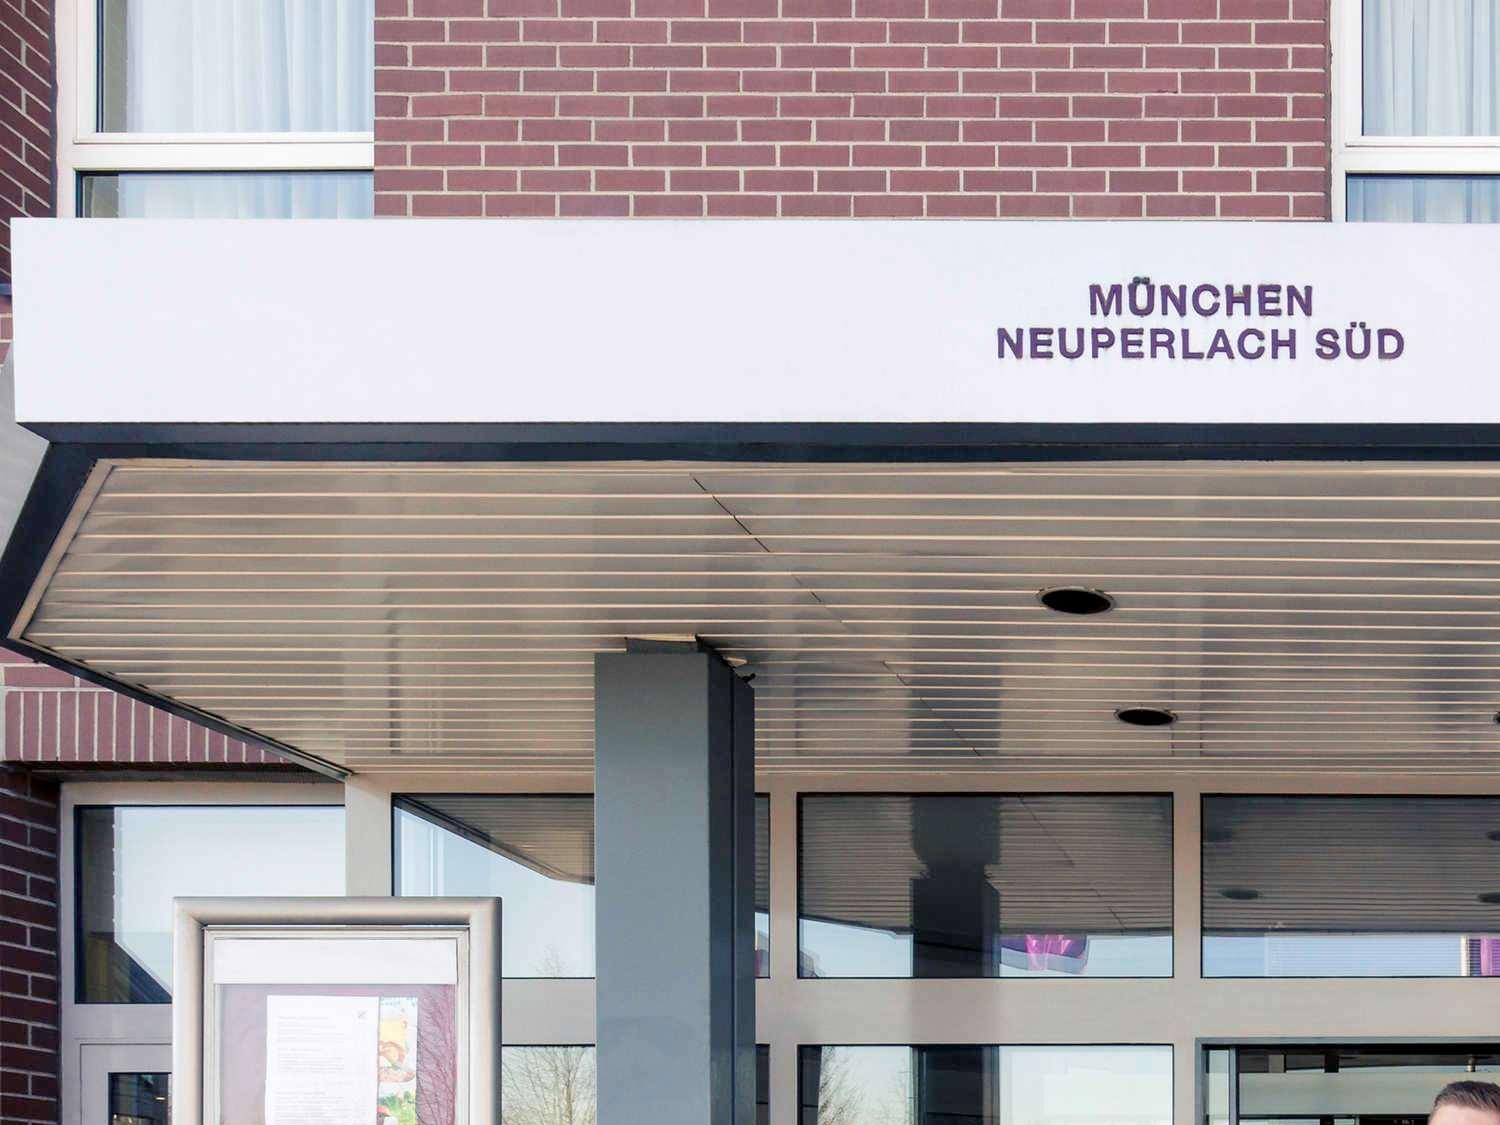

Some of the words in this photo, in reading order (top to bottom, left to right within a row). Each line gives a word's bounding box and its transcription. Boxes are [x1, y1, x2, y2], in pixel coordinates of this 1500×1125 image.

[1088, 276, 1315, 317] MÜNCHEN
[997, 327, 1298, 360] NEUPERLACH
[1315, 321, 1405, 360] SÜD
